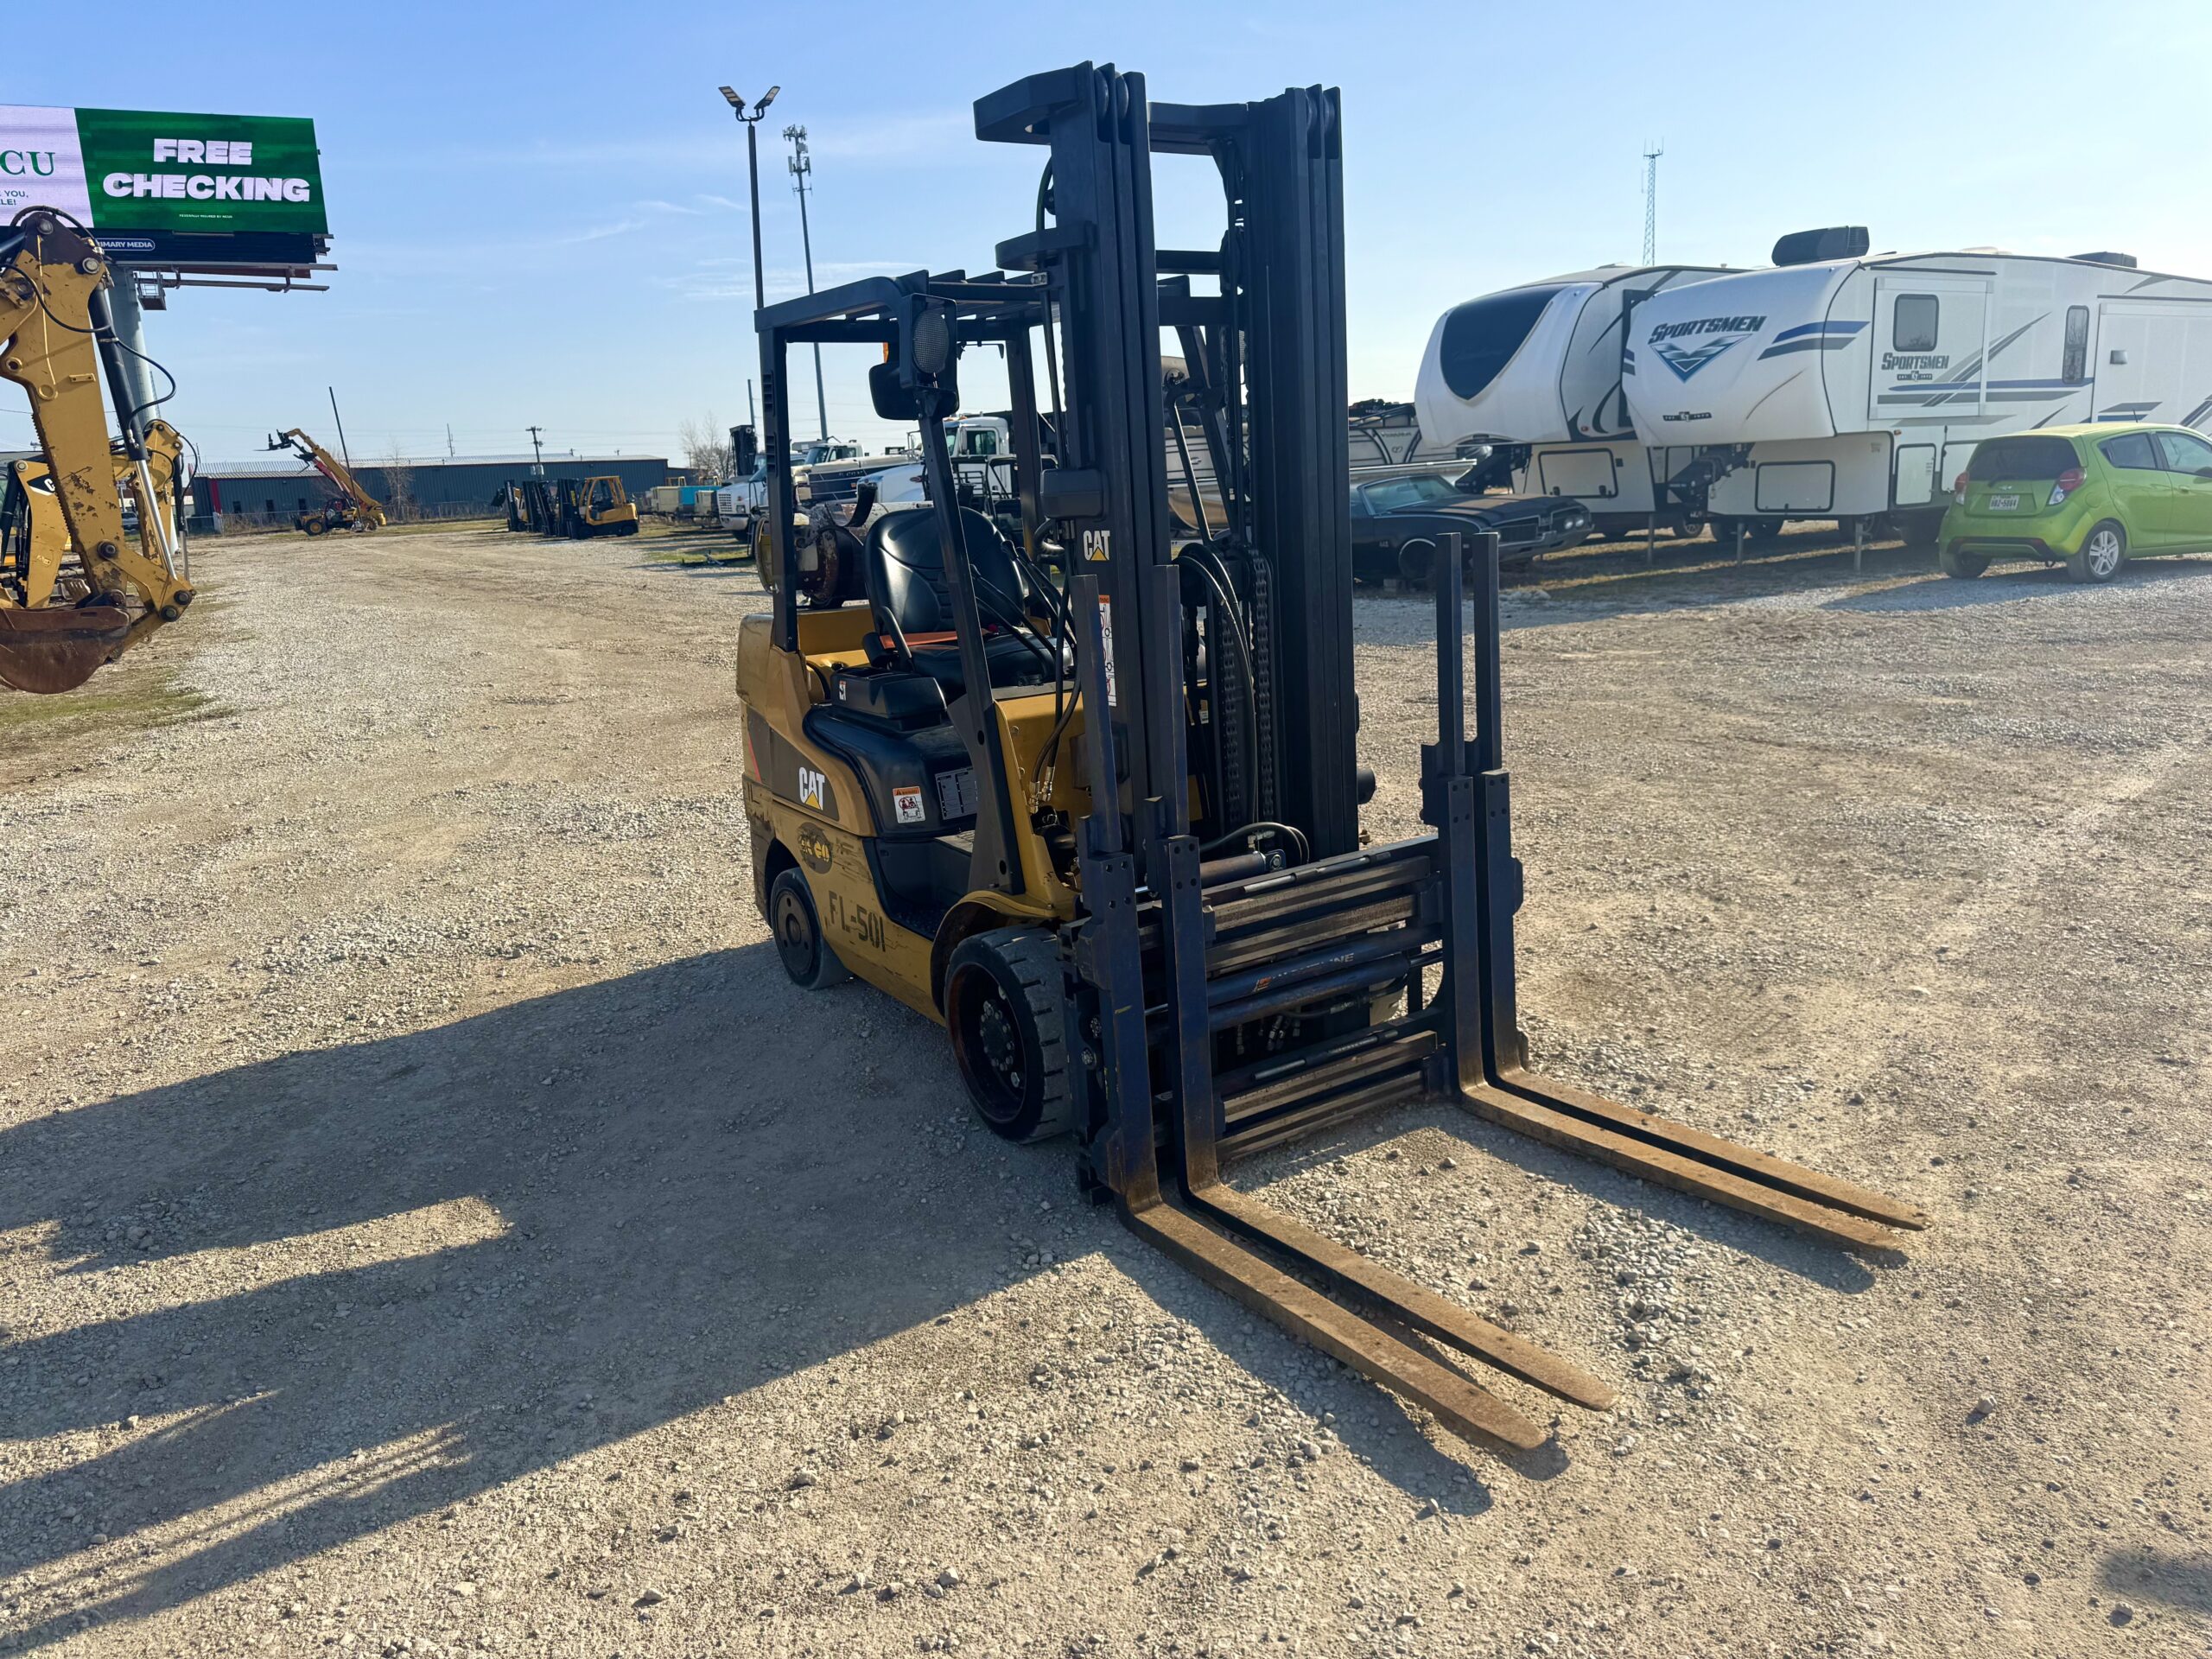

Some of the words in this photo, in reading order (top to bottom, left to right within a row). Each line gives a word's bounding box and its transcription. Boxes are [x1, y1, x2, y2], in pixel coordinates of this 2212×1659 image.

[154, 138, 252, 165] FREE
[103, 173, 309, 202] CHECKING
[1648, 315, 1767, 345] SPORTSMEN
[1881, 353, 1949, 370] SPORTSMEN
[1084, 530, 1110, 561] CAT
[799, 766, 825, 810] CAT
